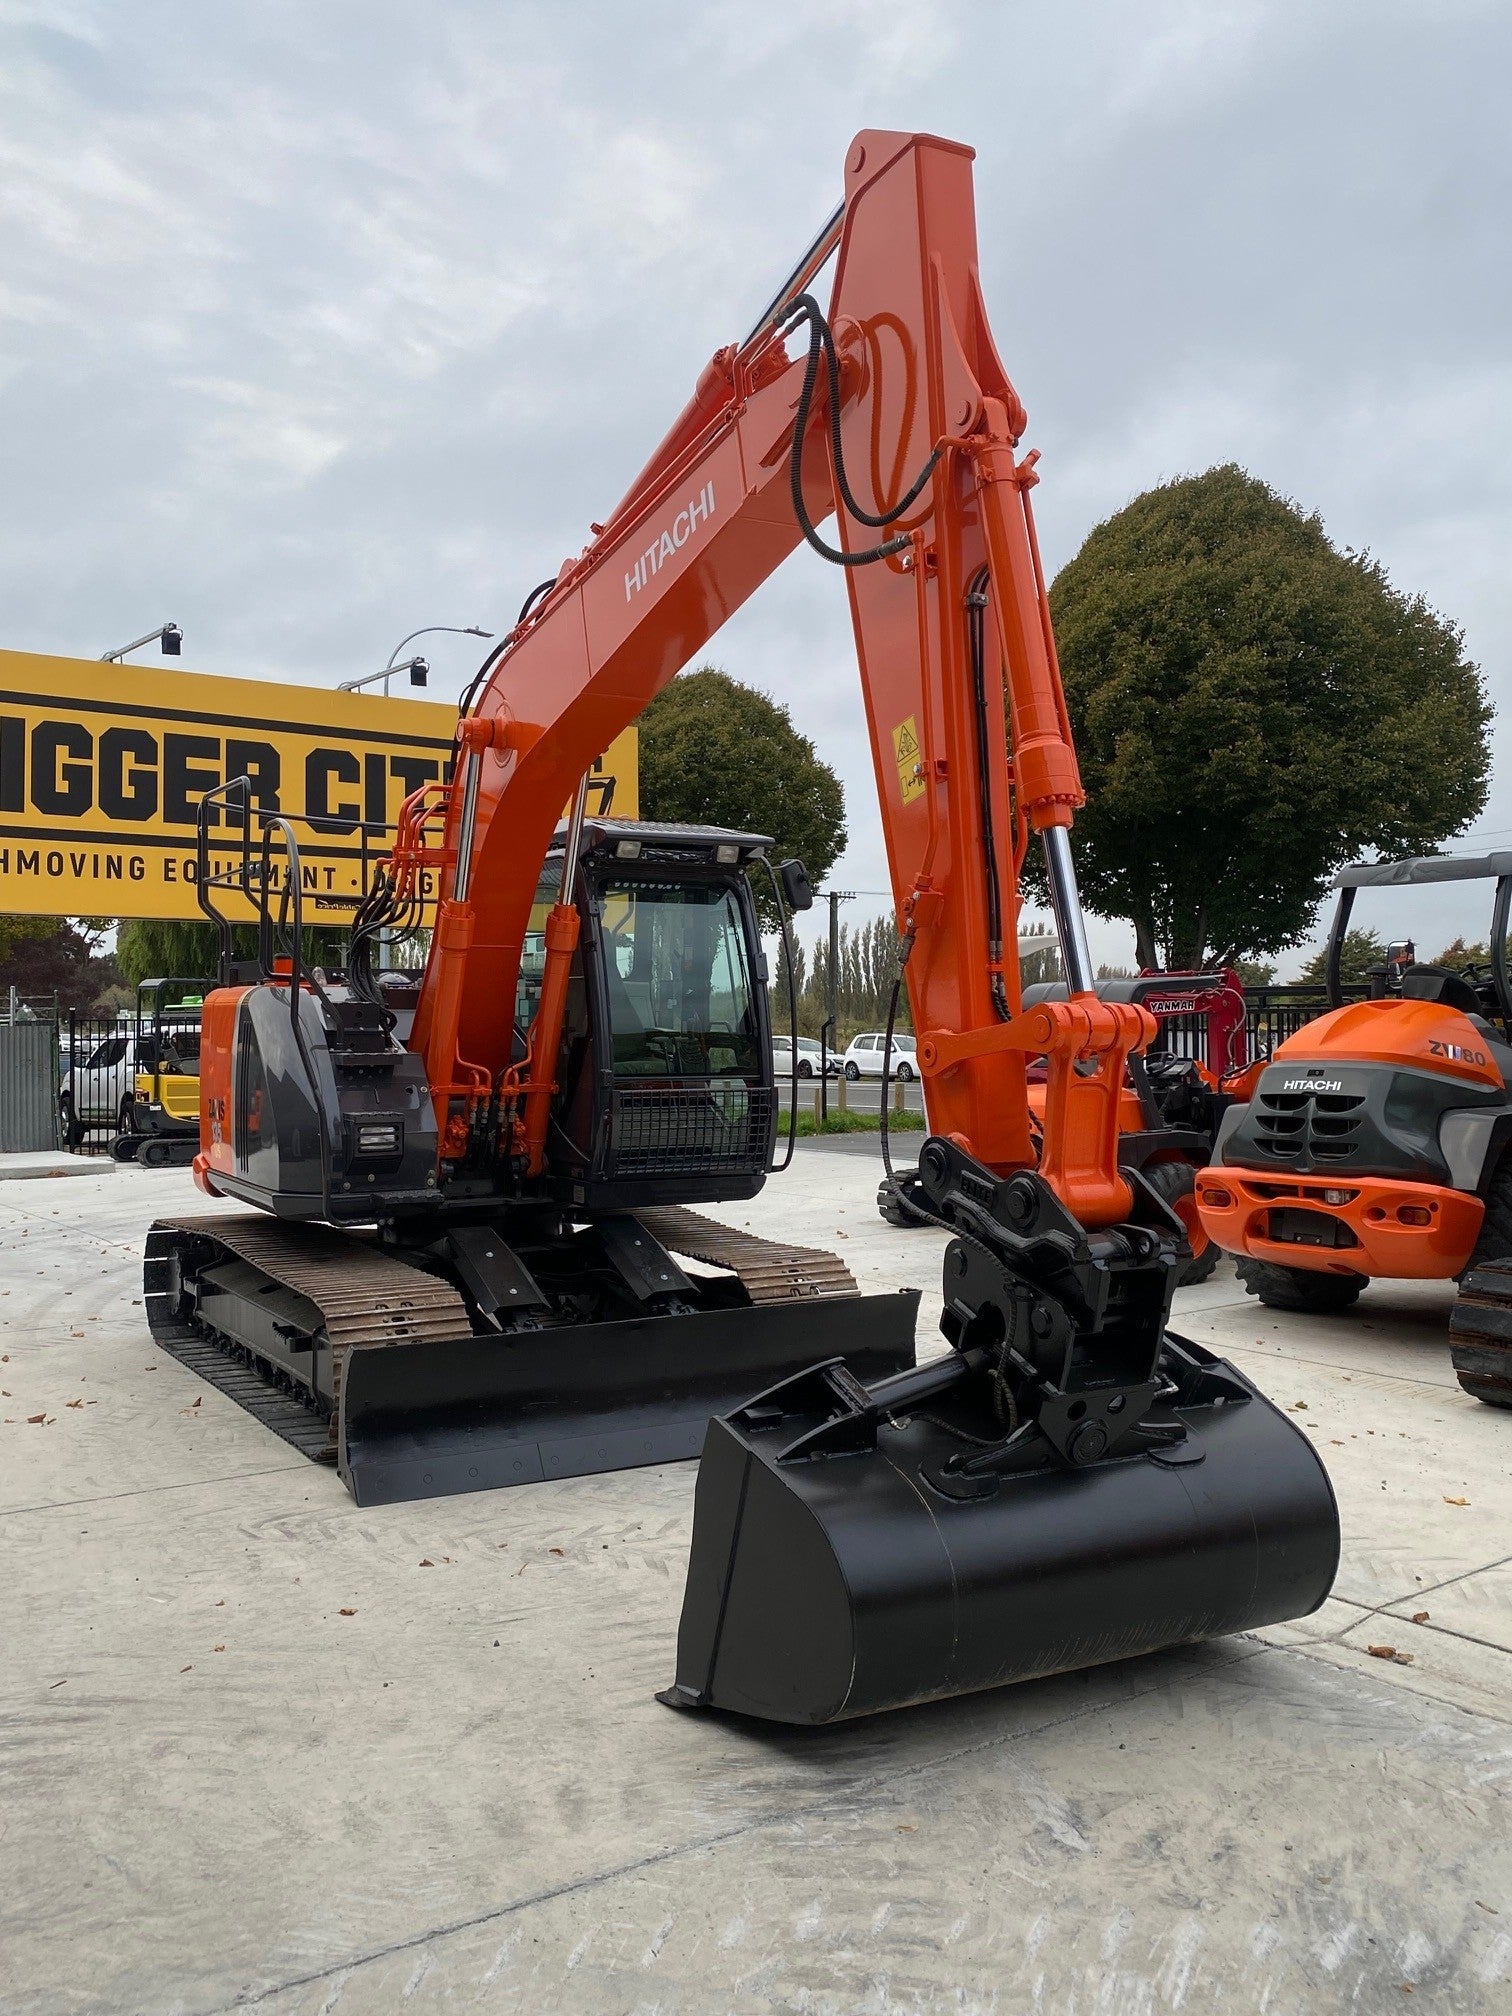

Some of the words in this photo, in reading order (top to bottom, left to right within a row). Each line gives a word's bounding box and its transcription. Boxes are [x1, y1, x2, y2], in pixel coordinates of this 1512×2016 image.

[624, 480, 716, 603] HITACHI
[305, 748, 451, 843] CIT
[1150, 1001, 1195, 1012] YANMAR
[1283, 1080, 1342, 1092] HITACHI
